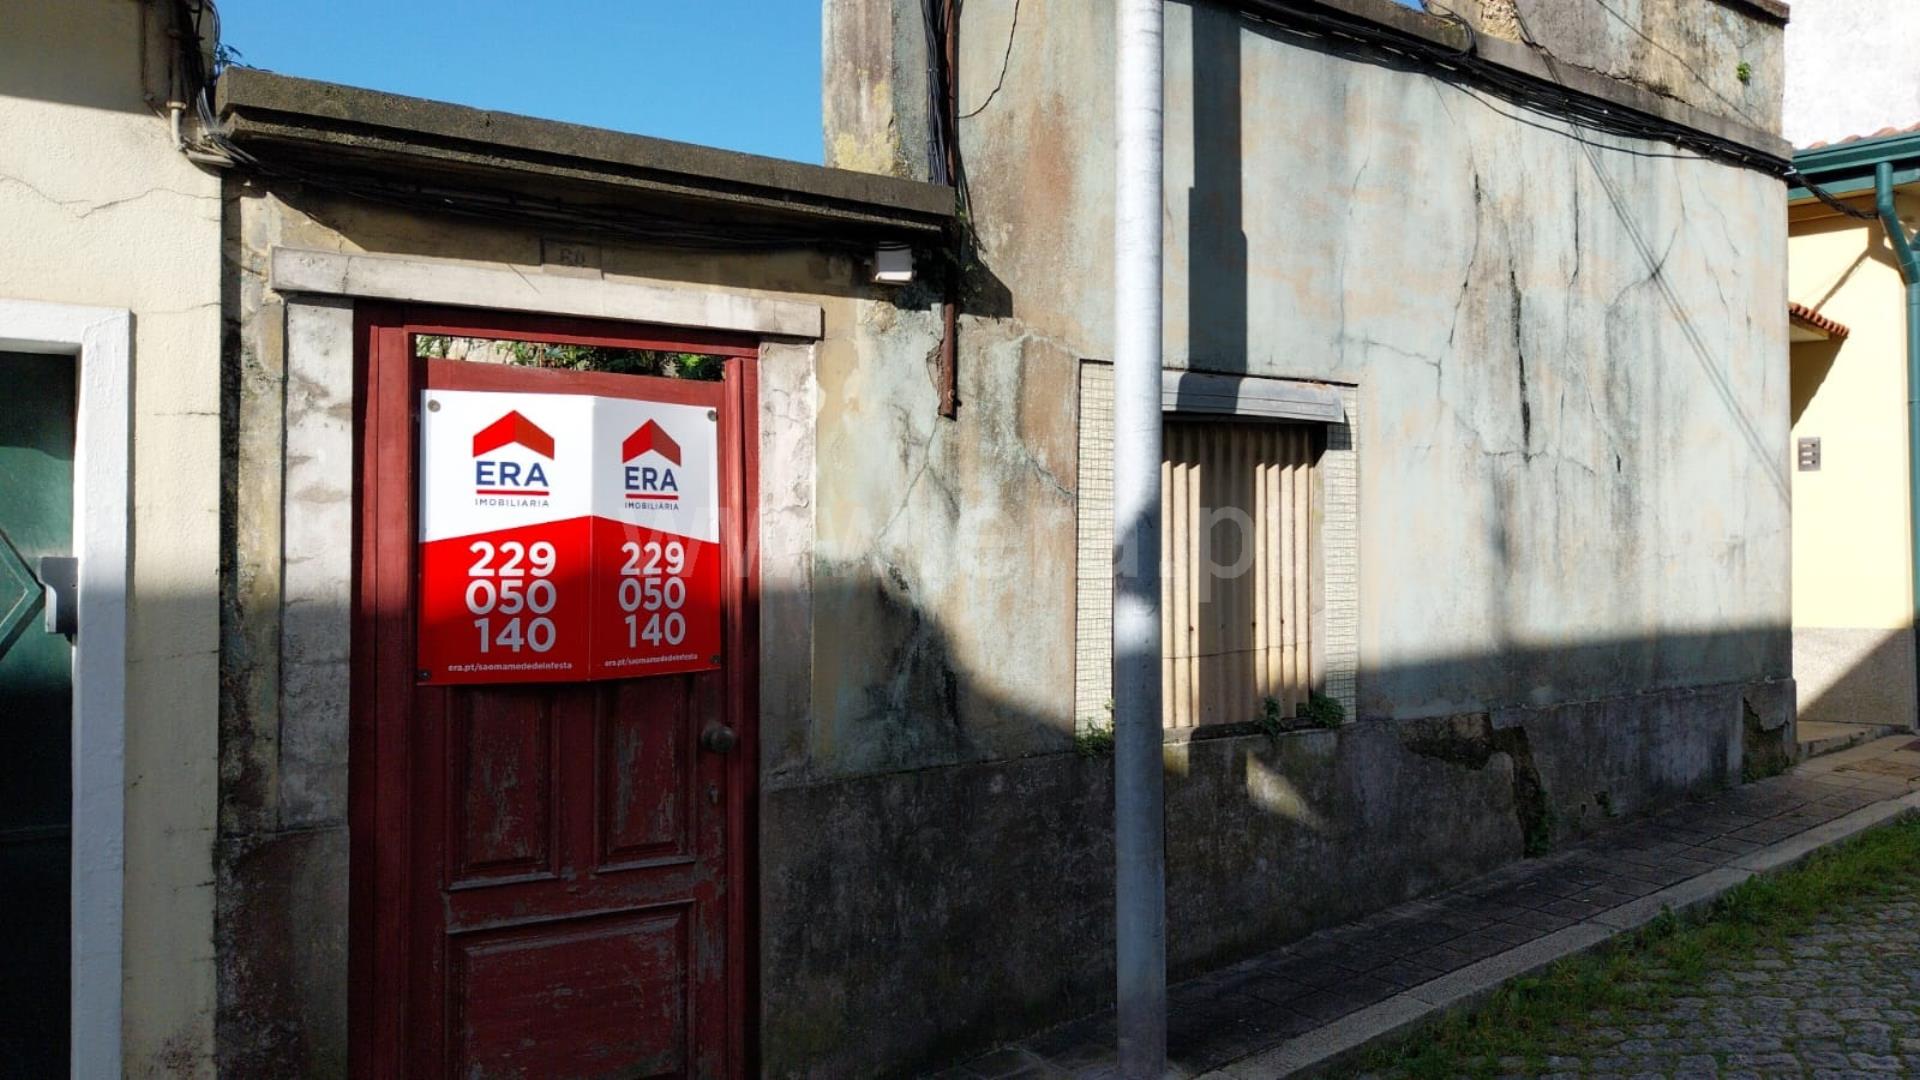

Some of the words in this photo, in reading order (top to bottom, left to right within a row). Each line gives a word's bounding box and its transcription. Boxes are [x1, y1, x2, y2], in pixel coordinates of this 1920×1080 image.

[475, 460, 549, 487] ERA
[624, 466, 678, 491] ERA
[467, 540, 557, 577] 229
[620, 540, 686, 576] 229
[465, 578, 557, 615] 050
[618, 576, 686, 612] 050
[474, 617, 556, 653] 140
[624, 611, 686, 648] 140
